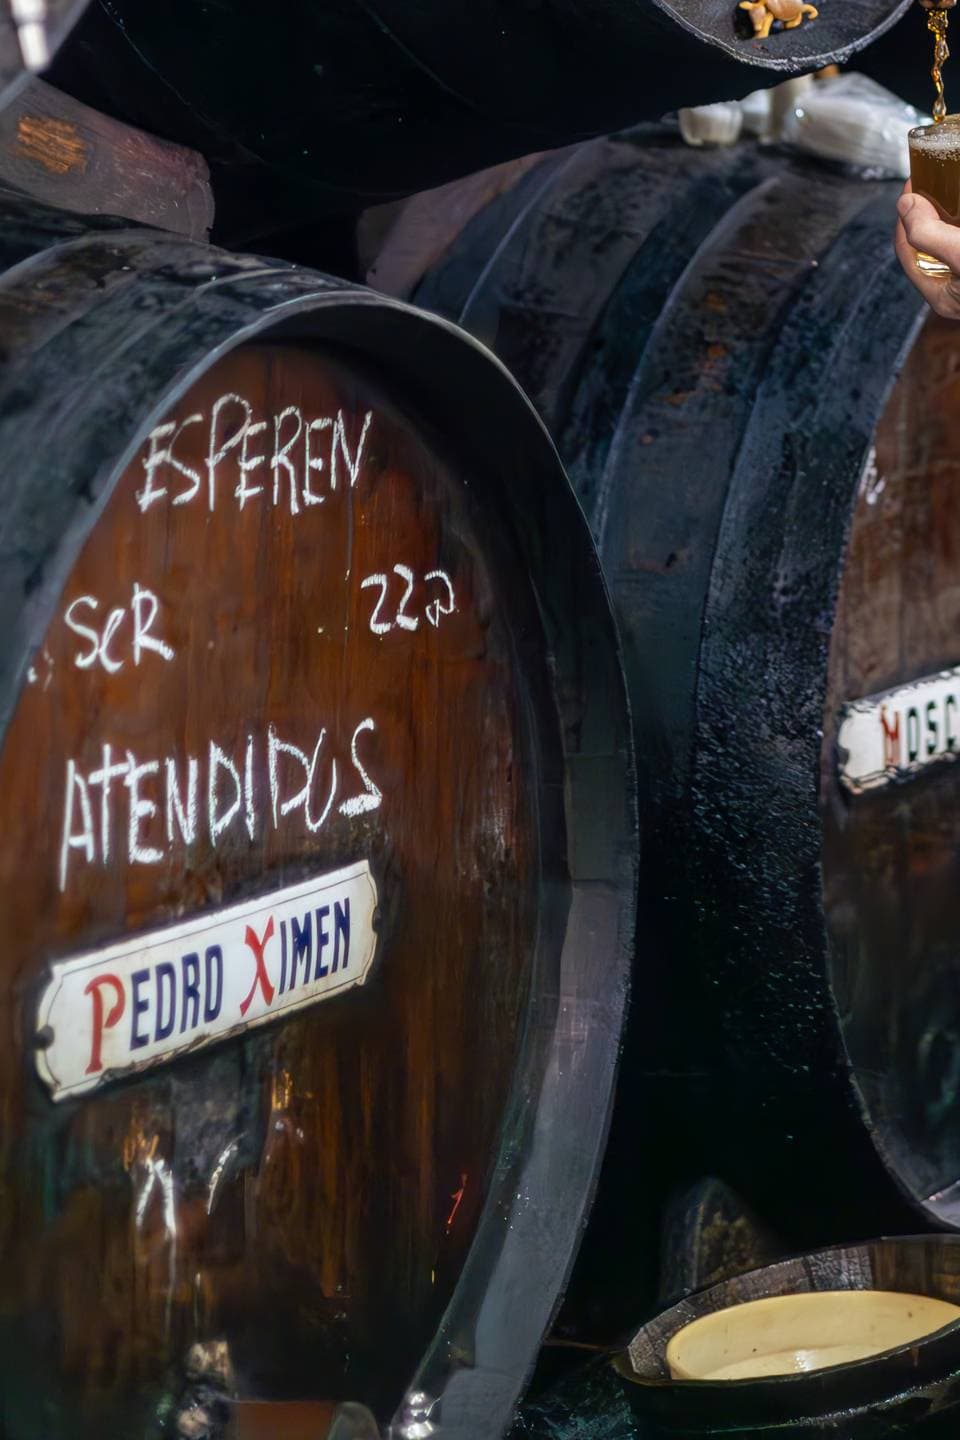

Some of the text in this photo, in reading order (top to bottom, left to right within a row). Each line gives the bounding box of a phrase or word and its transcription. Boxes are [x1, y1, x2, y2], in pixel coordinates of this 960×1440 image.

[138, 393, 373, 514] ESPEREN
[84, 896, 351, 1074] PEDRO XIMEN
